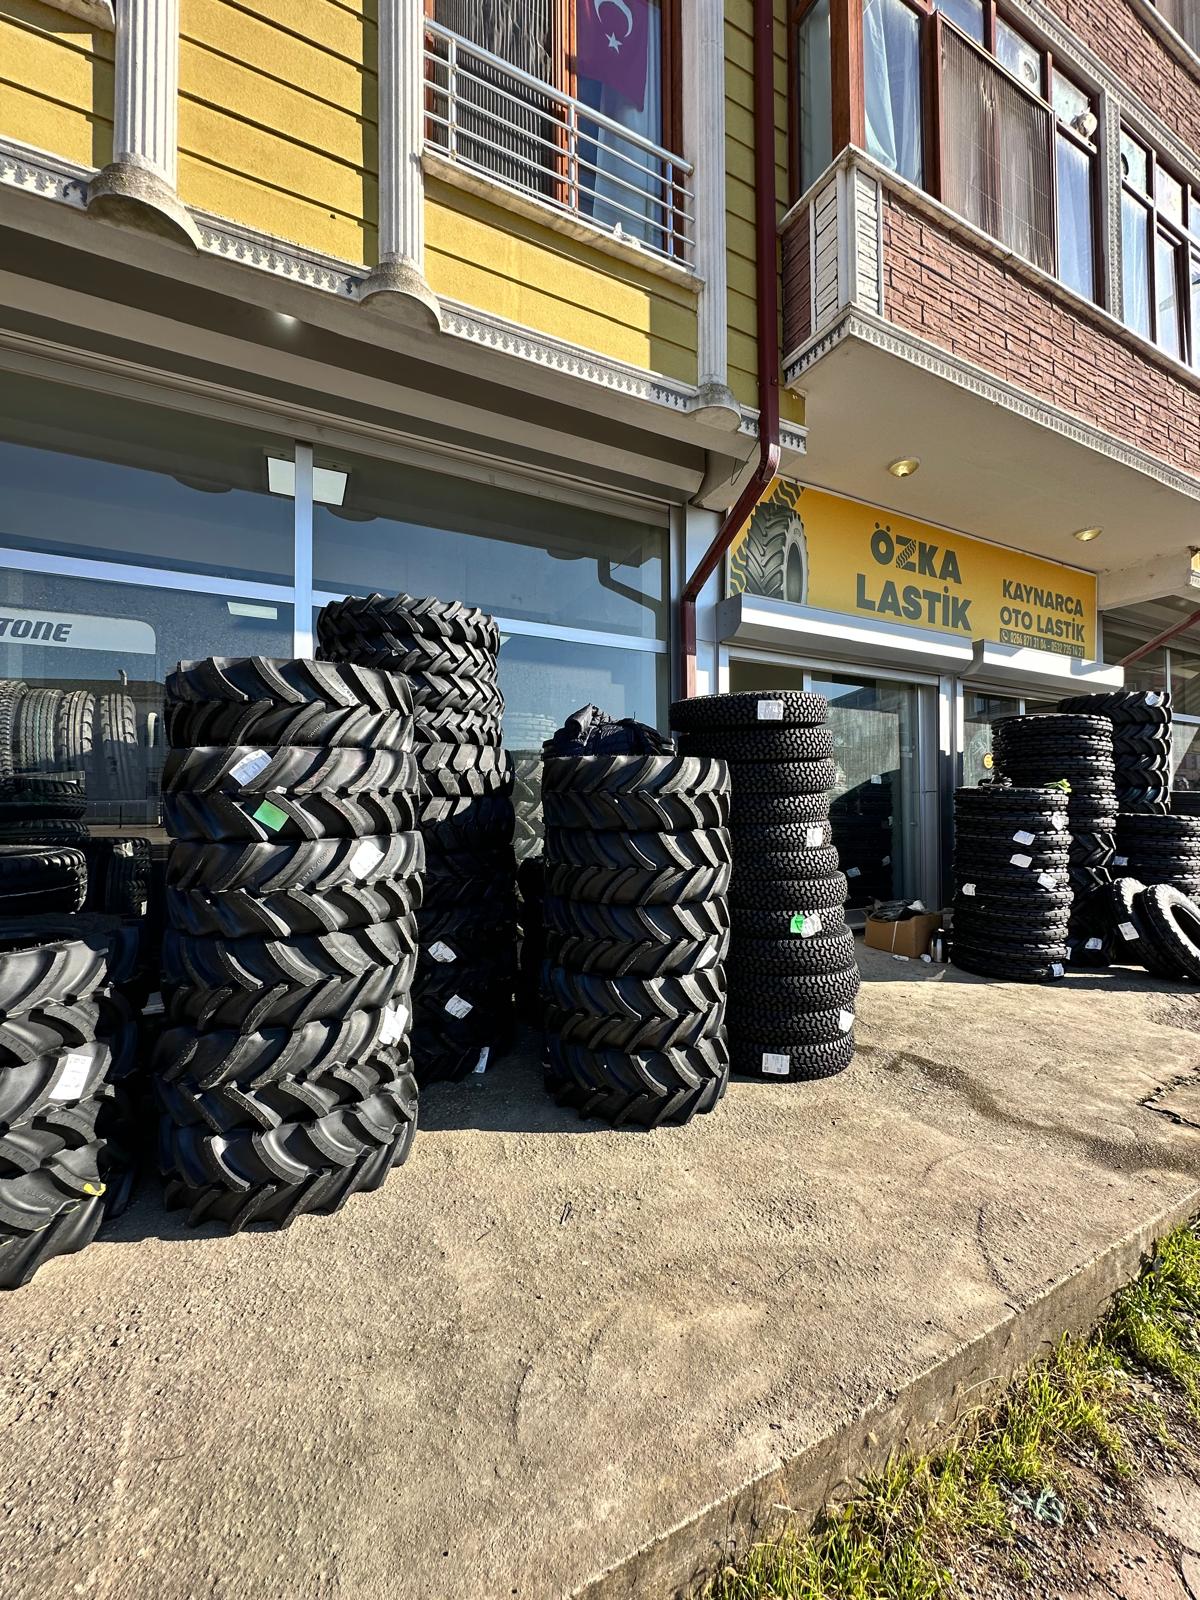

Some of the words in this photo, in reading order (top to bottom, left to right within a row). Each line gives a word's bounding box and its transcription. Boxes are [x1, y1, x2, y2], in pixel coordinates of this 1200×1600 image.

[870, 521, 962, 585] ÖZKA
[856, 573, 972, 632] LASTİK
[1003, 580, 1083, 617] KAYNARCA
[1000, 606, 1032, 630] OTO
[1037, 615, 1084, 642] LASTİK
